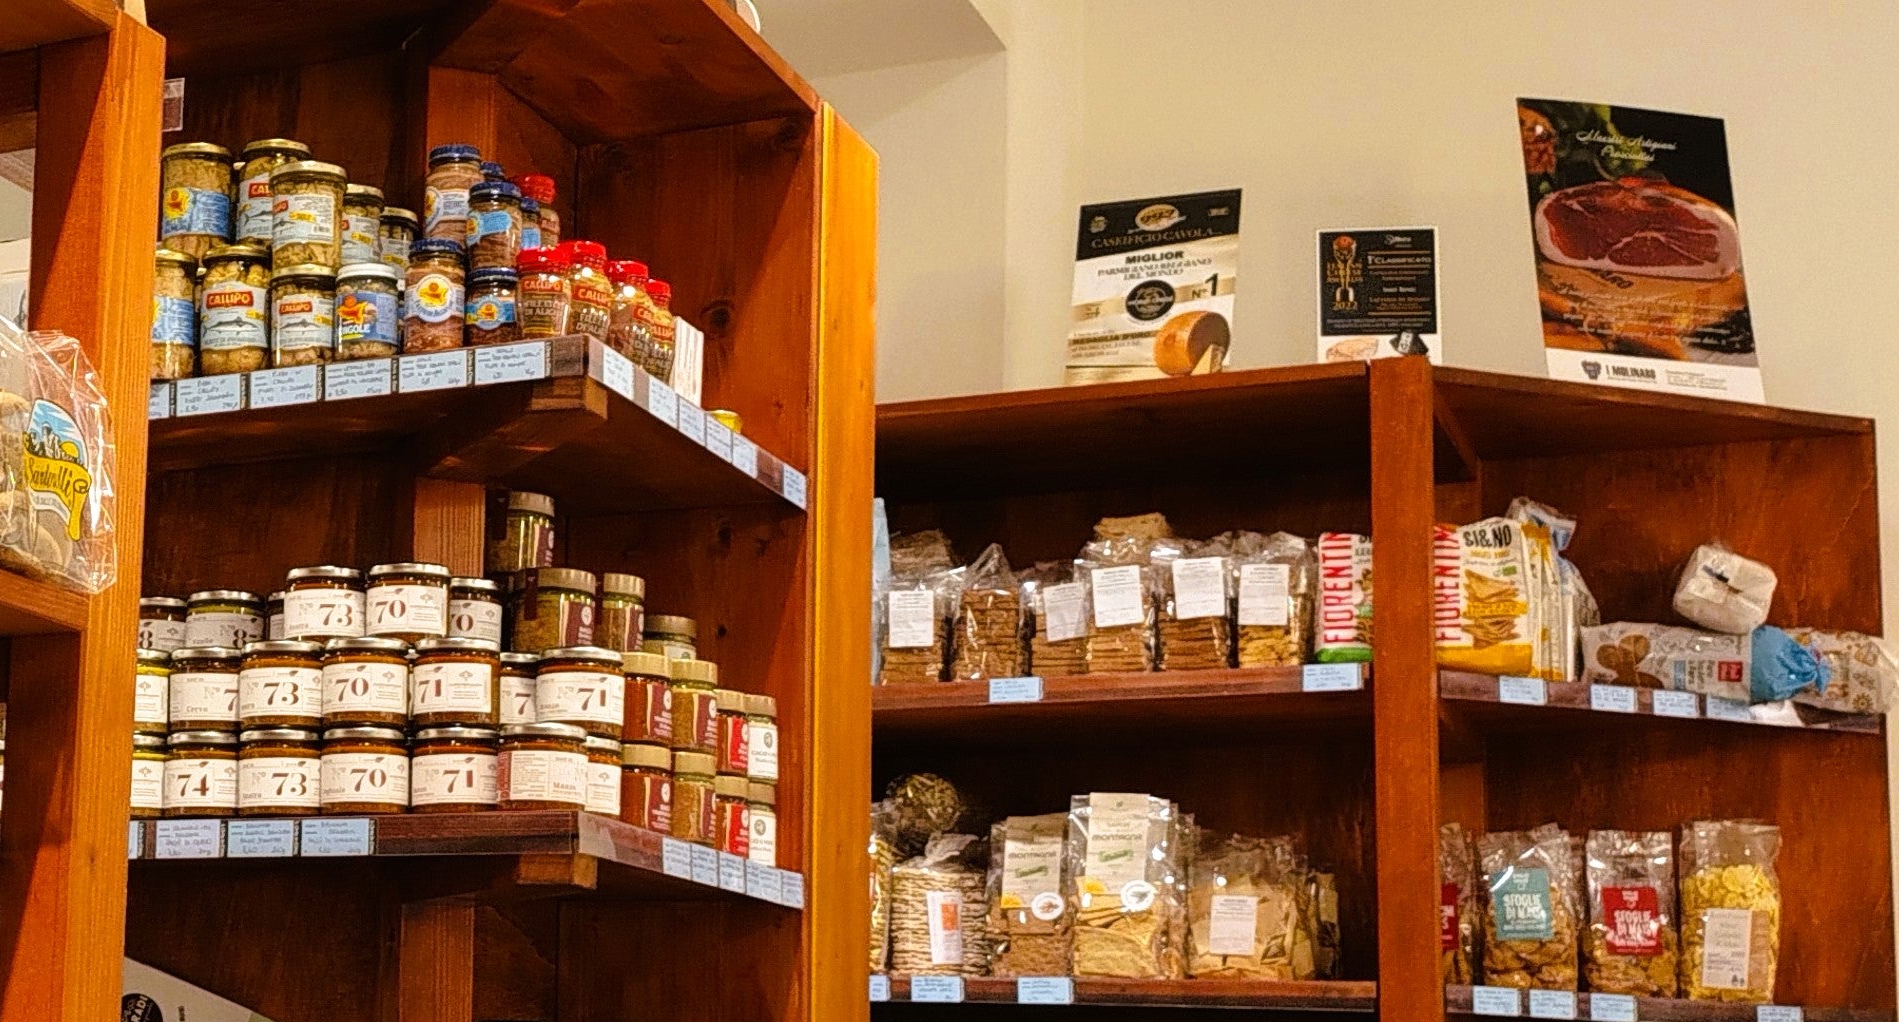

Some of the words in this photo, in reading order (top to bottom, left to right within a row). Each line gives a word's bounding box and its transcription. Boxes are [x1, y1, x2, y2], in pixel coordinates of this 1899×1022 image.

[1125, 251, 1184, 264] MIGLIOR
[208, 292, 251, 305] CALLIPO
[320, 603, 352, 626] 73
[376, 600, 406, 624] 70
[263, 682, 299, 705] 73
[336, 678, 369, 702] 70
[419, 679, 442, 703] 71
[577, 687, 607, 711] 71
[176, 774, 209, 796] 74
[271, 773, 307, 796] 73
[351, 769, 387, 792] 70
[443, 769, 474, 793] 71
